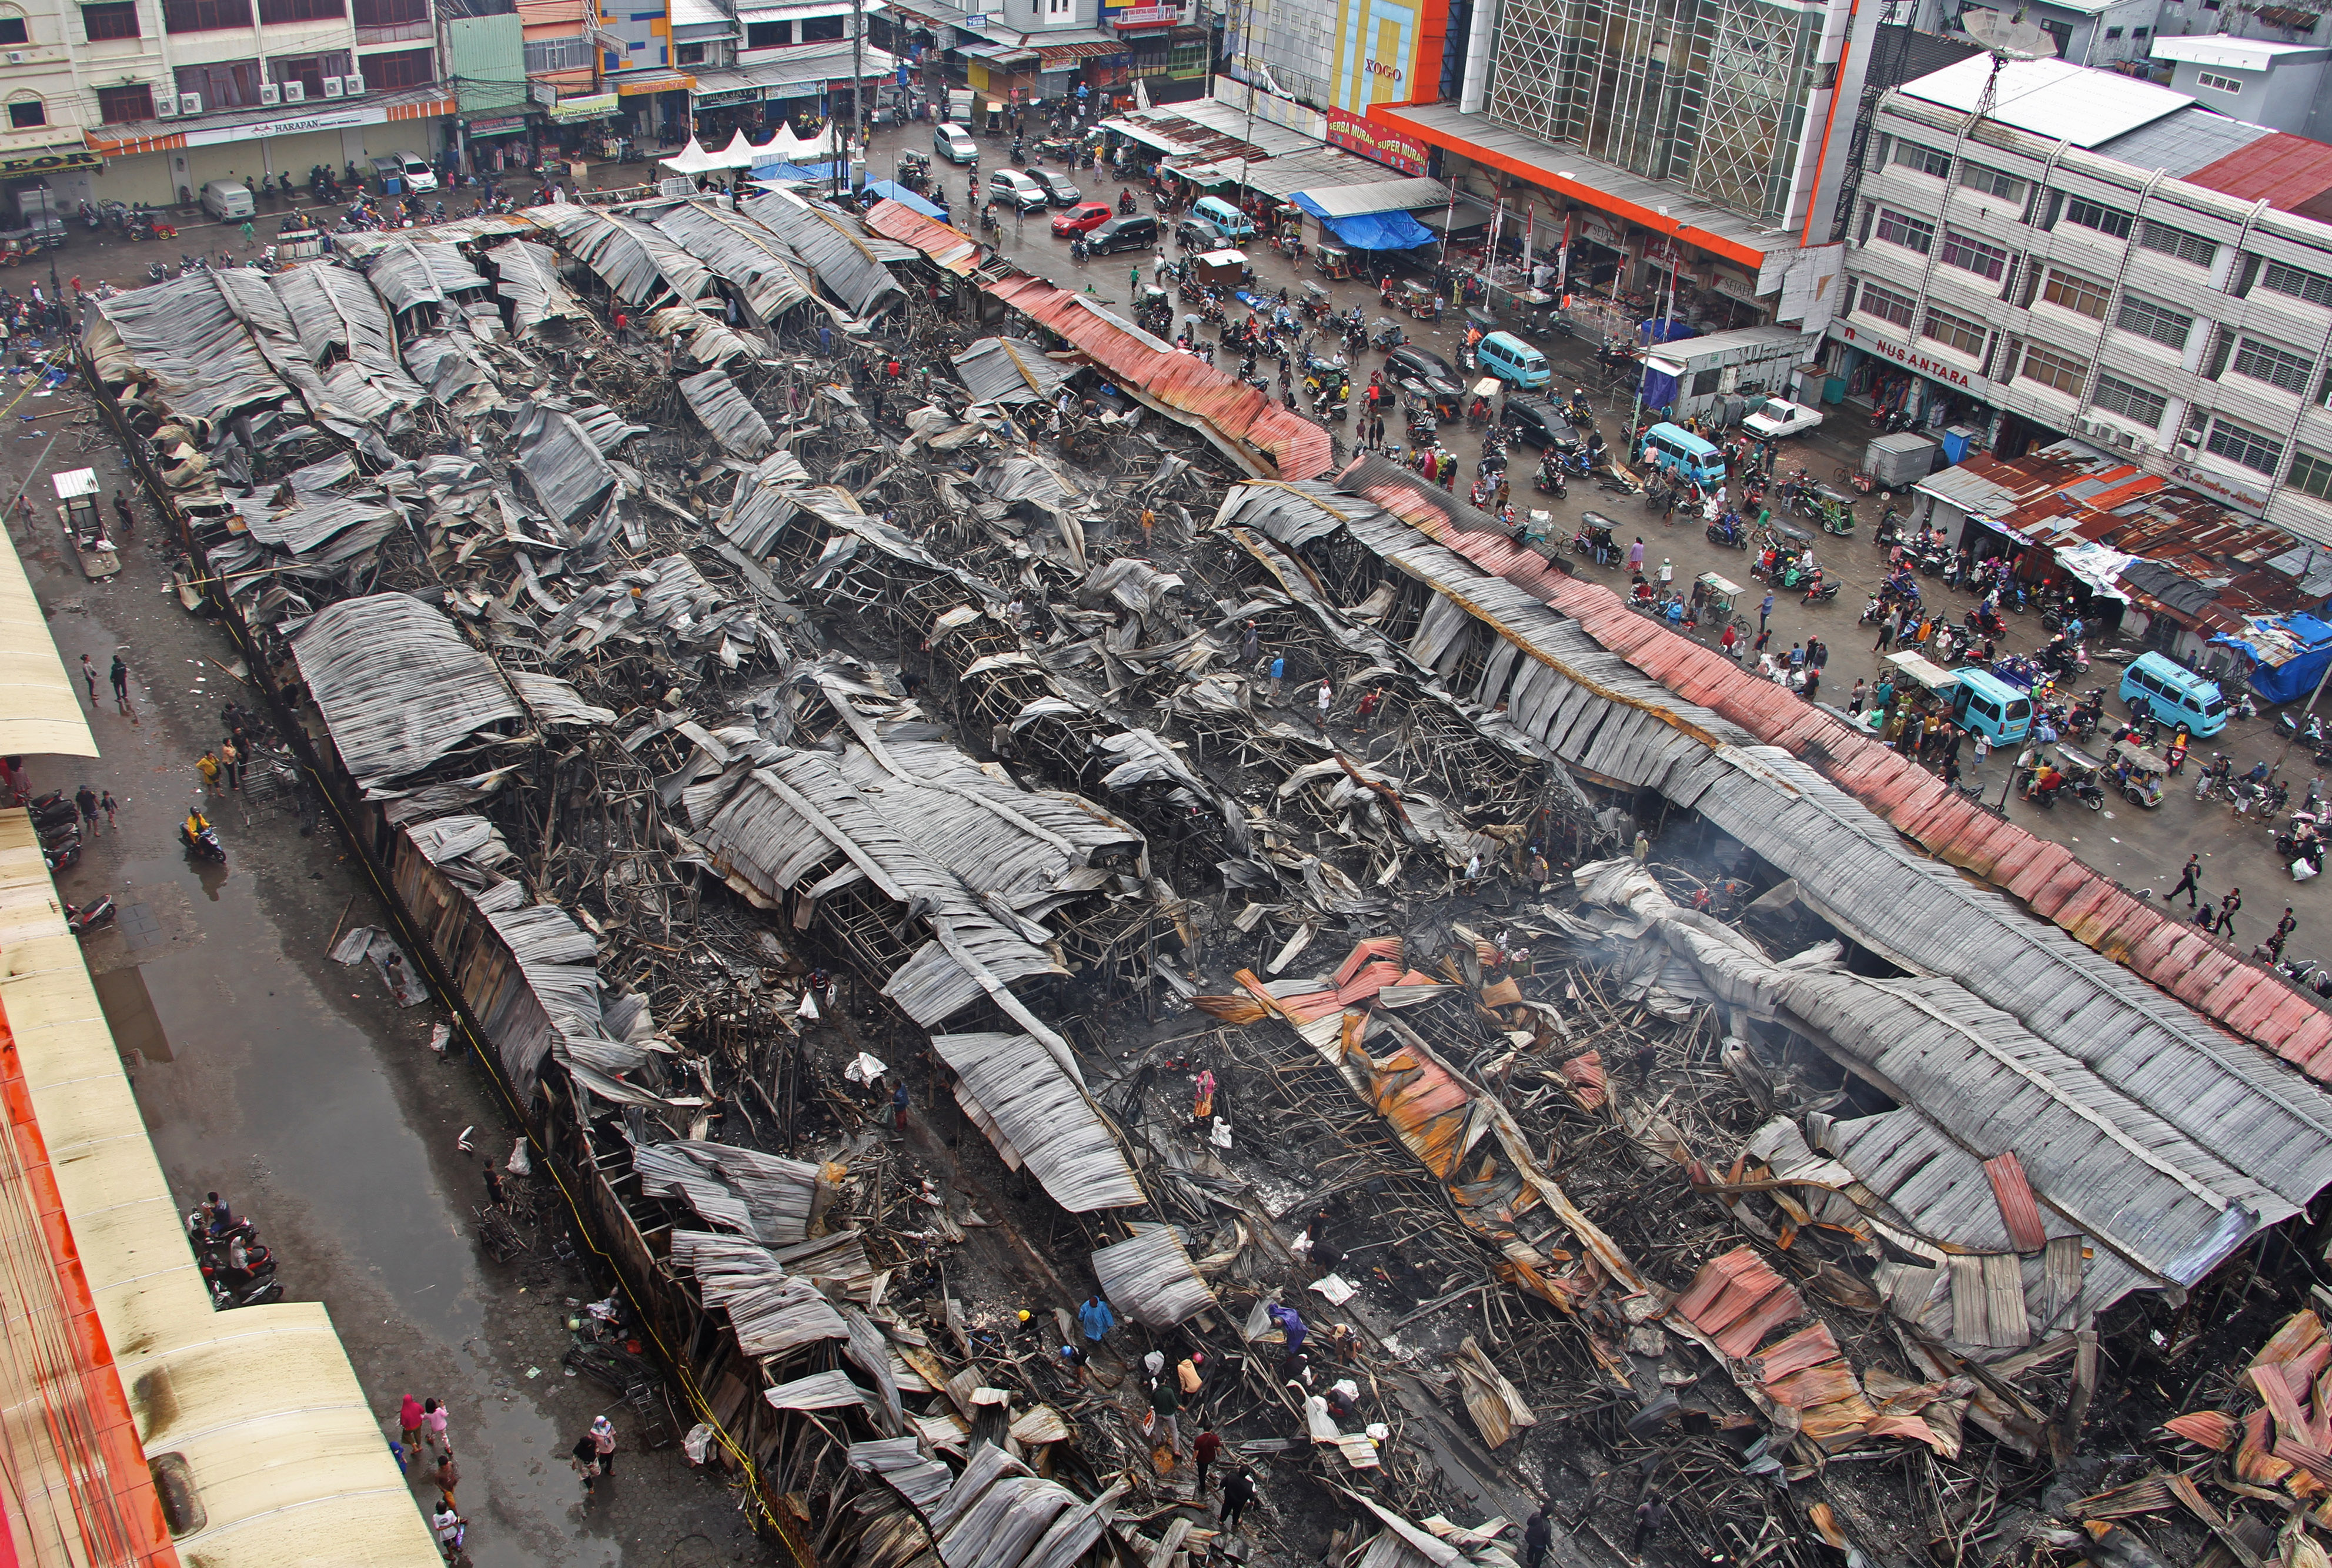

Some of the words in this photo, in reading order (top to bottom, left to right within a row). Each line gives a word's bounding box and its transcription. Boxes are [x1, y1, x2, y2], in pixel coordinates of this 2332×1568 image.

[1365, 58, 1402, 81] XOGO
[633, 83, 667, 93] SUMBER
[730, 89, 756, 97] JAYA
[275, 120, 319, 132] HARAPAN
[1329, 121, 1349, 135] SERBA
[1351, 123, 1375, 146] MURAH
[1377, 140, 1400, 153] SUPER
[1401, 143, 1426, 165] MURAH
[1876, 339, 1969, 388] NUSANTARA
